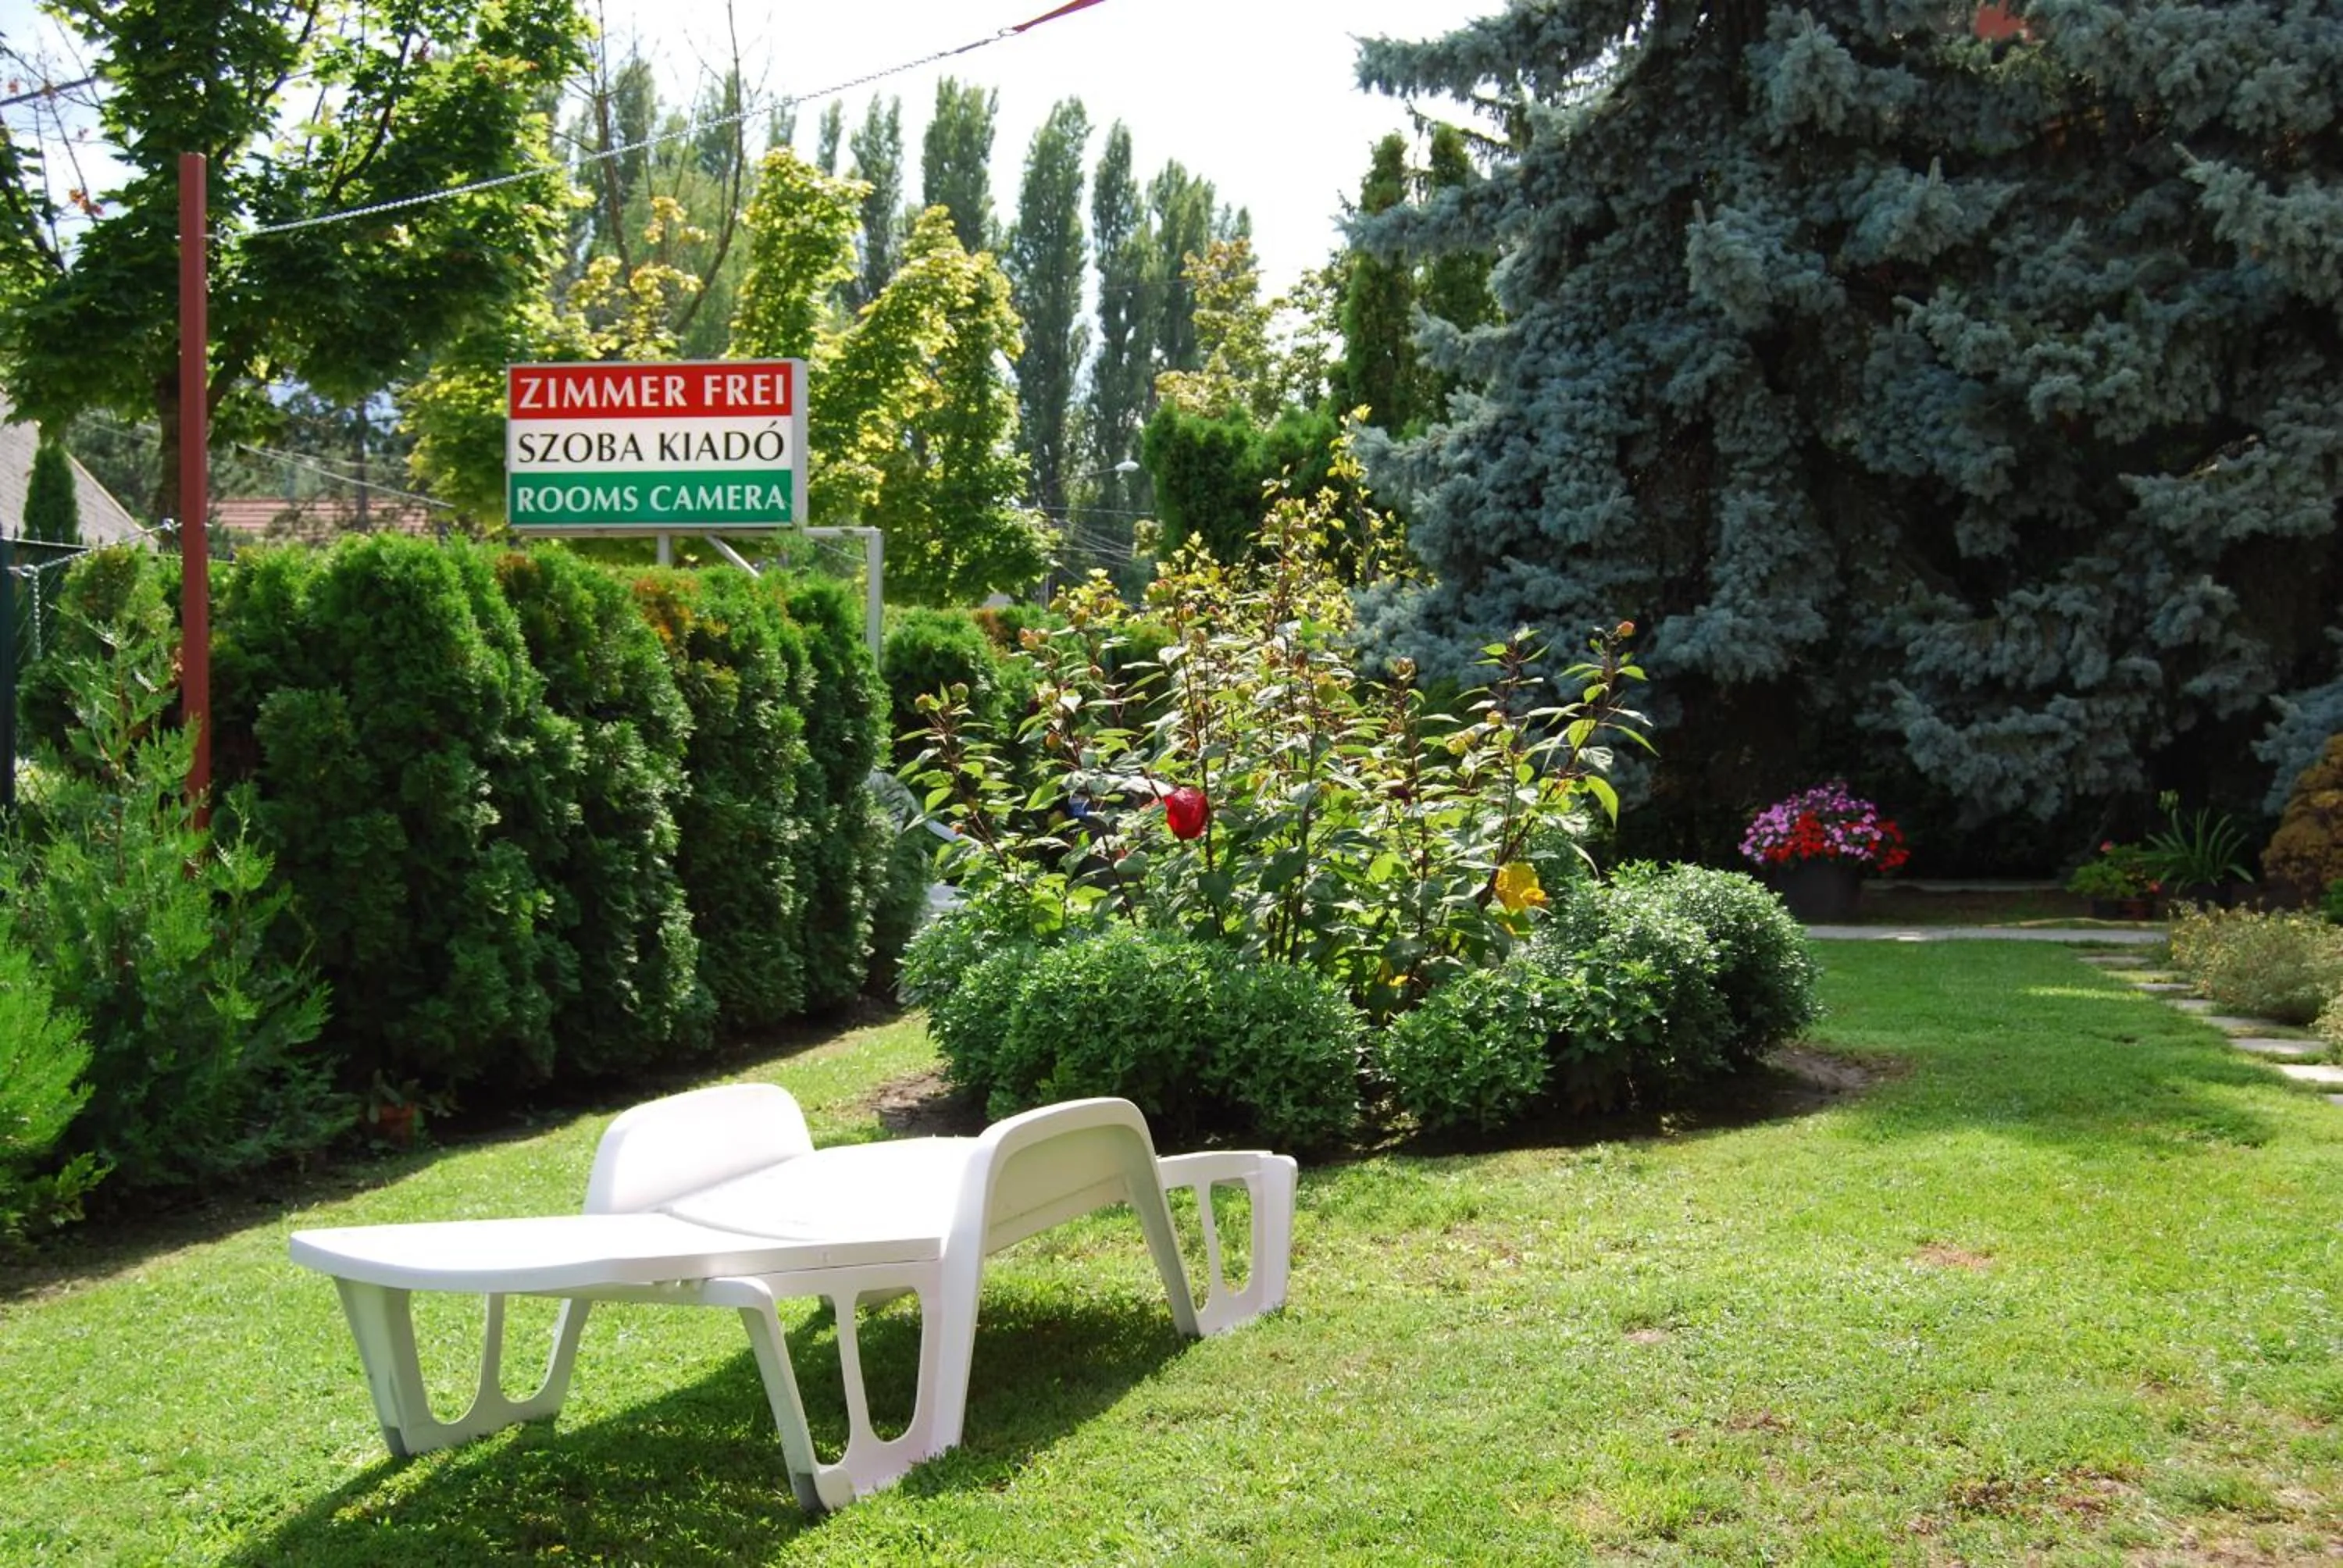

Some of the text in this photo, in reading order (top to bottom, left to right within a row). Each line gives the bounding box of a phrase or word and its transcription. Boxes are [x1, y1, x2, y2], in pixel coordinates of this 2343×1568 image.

[519, 373, 785, 409] ZIMMER FREI
[518, 419, 785, 463] SZOBA KIADÓ
[516, 484, 786, 512] ROOMS CAMERA
